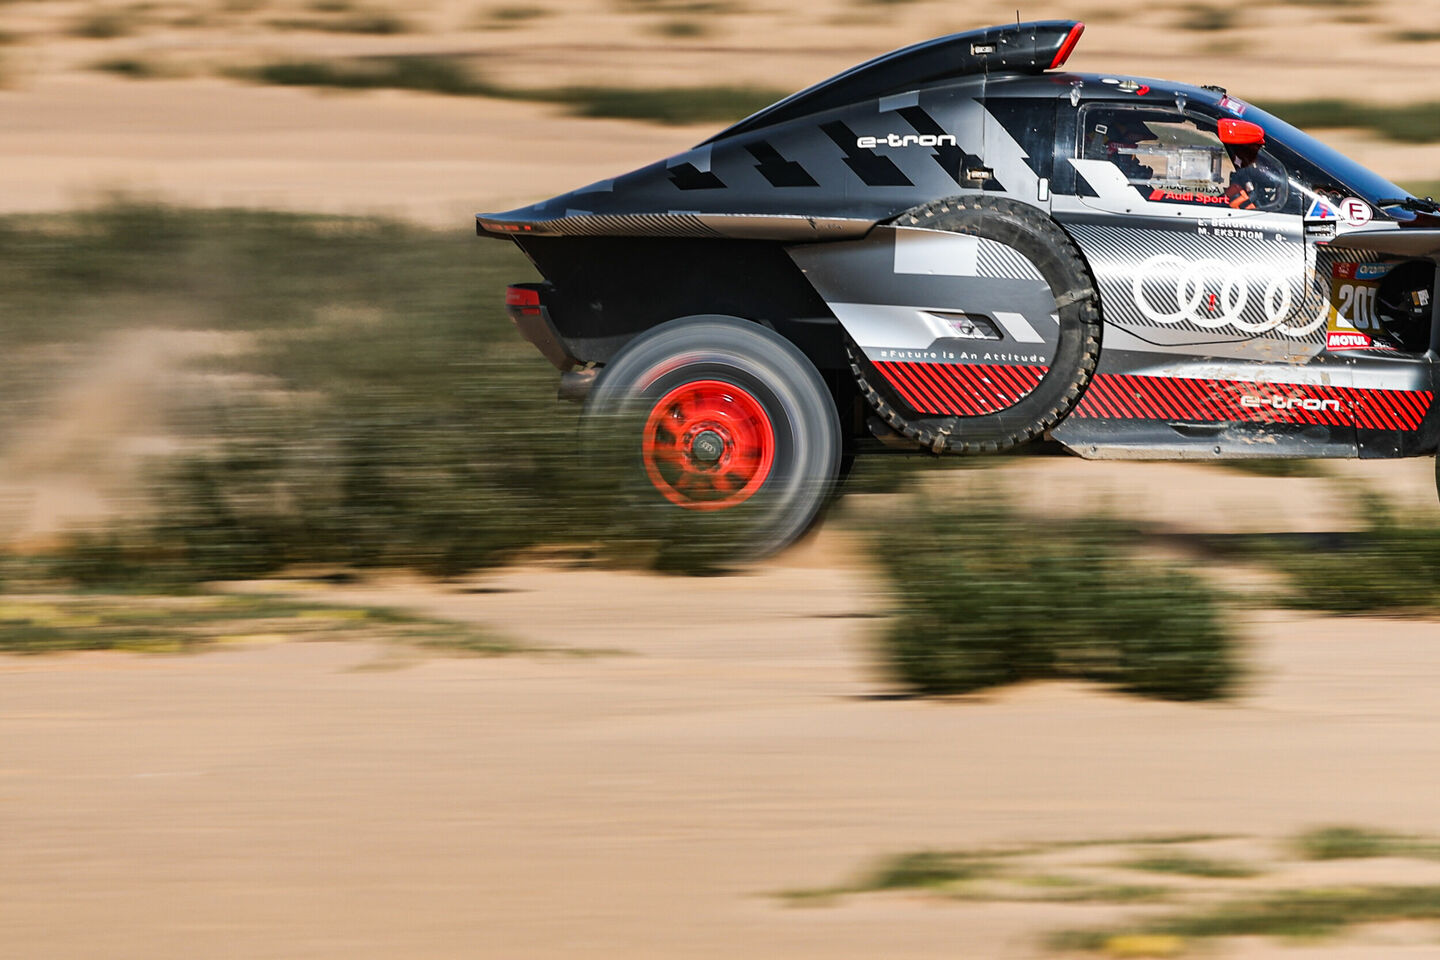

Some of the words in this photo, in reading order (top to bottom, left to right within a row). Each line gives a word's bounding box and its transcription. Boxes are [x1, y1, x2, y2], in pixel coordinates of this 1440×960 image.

[857, 133, 957, 148] e-tron
[1165, 191, 1193, 201] Audi
[1195, 193, 1230, 204] Sport
[1328, 335, 1369, 347] MOTUL
[960, 351, 978, 360] An
[983, 352, 1046, 363] Attitude
[1240, 394, 1340, 411] e-tron
